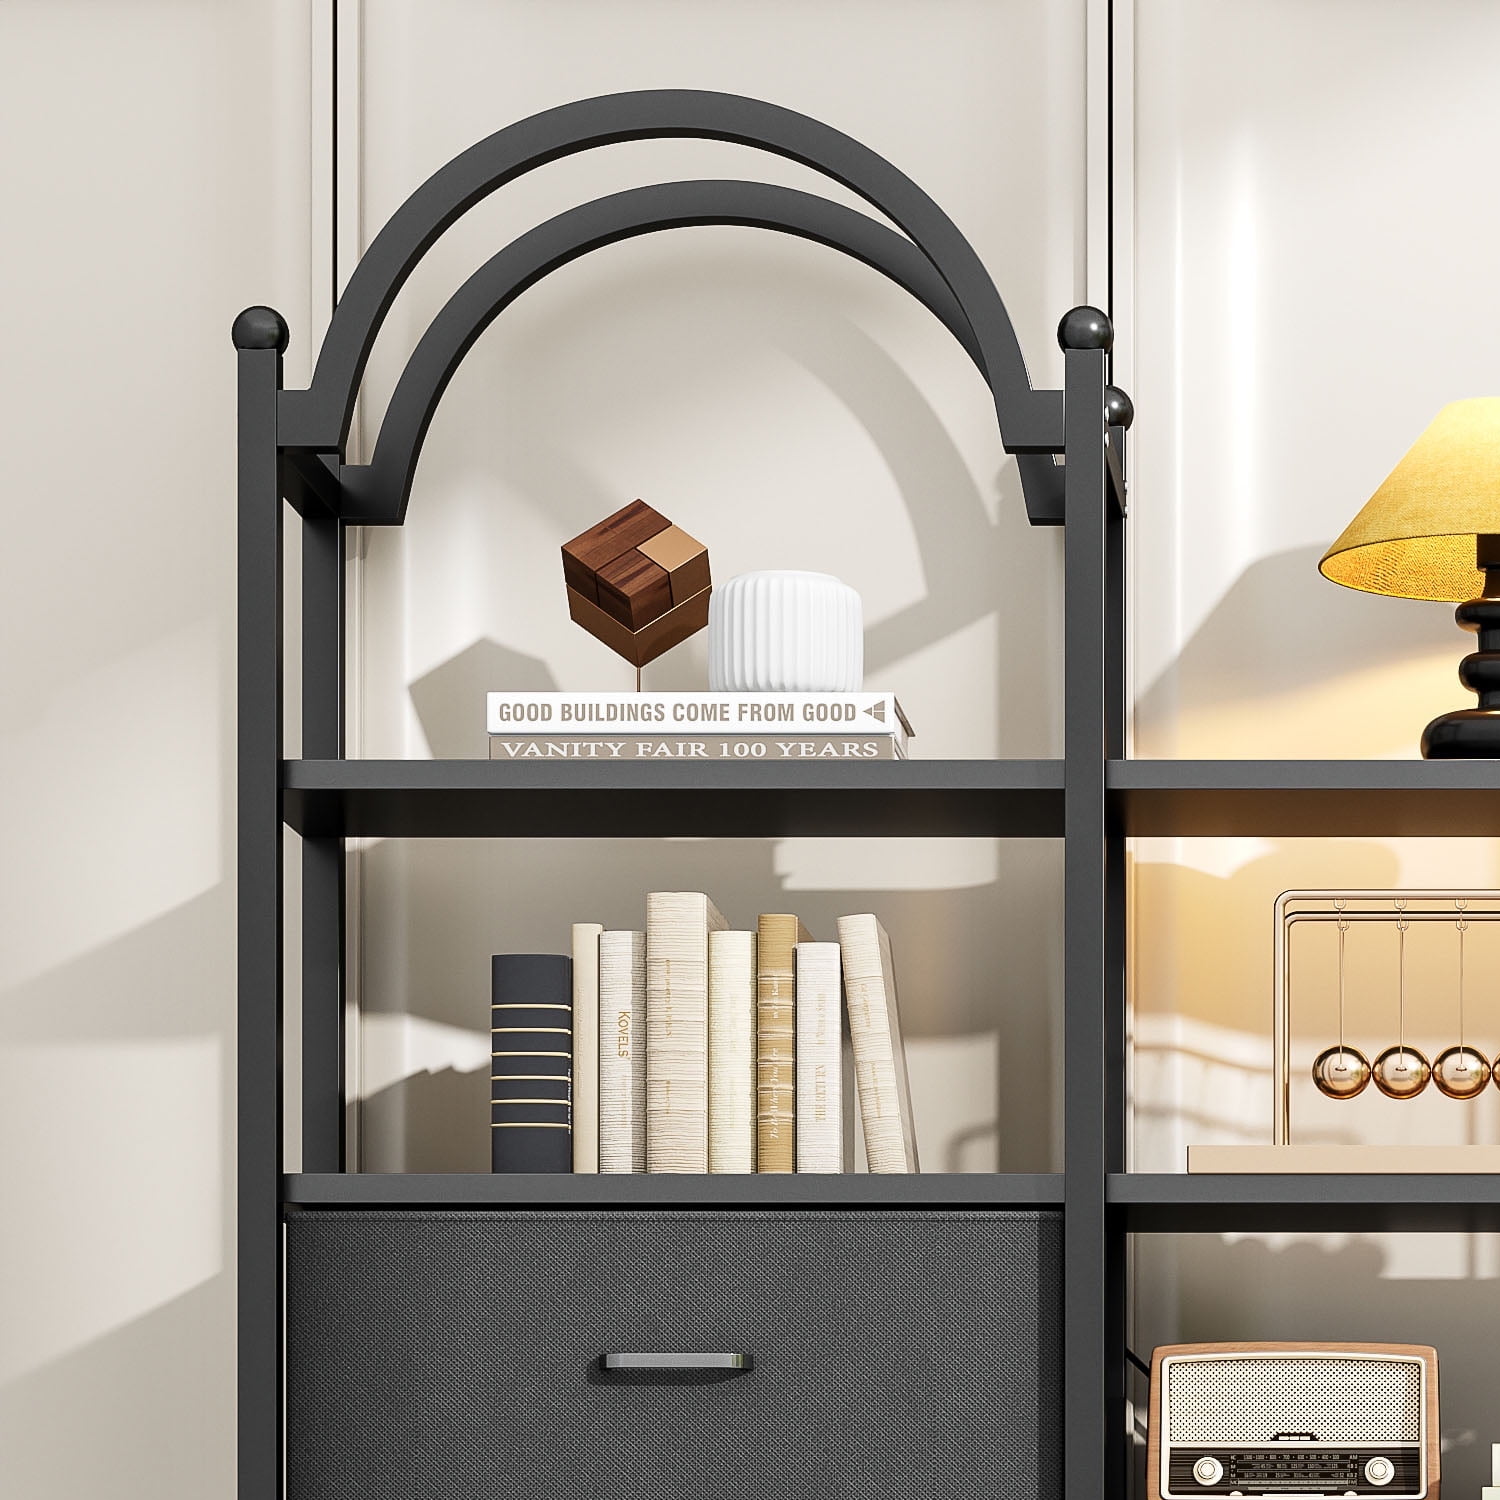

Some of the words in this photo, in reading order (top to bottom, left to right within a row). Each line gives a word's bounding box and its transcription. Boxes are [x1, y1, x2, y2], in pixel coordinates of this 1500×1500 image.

[499, 703, 553, 722] GOOD
[561, 703, 666, 722] BUILDINGS
[672, 703, 730, 722] COME
[738, 703, 795, 722] FROM
[803, 703, 856, 722] GOOD
[500, 742, 626, 757] VANITY
[636, 742, 709, 757] FAIR
[719, 742, 766, 757] 100
[775, 742, 879, 757] YEARS
